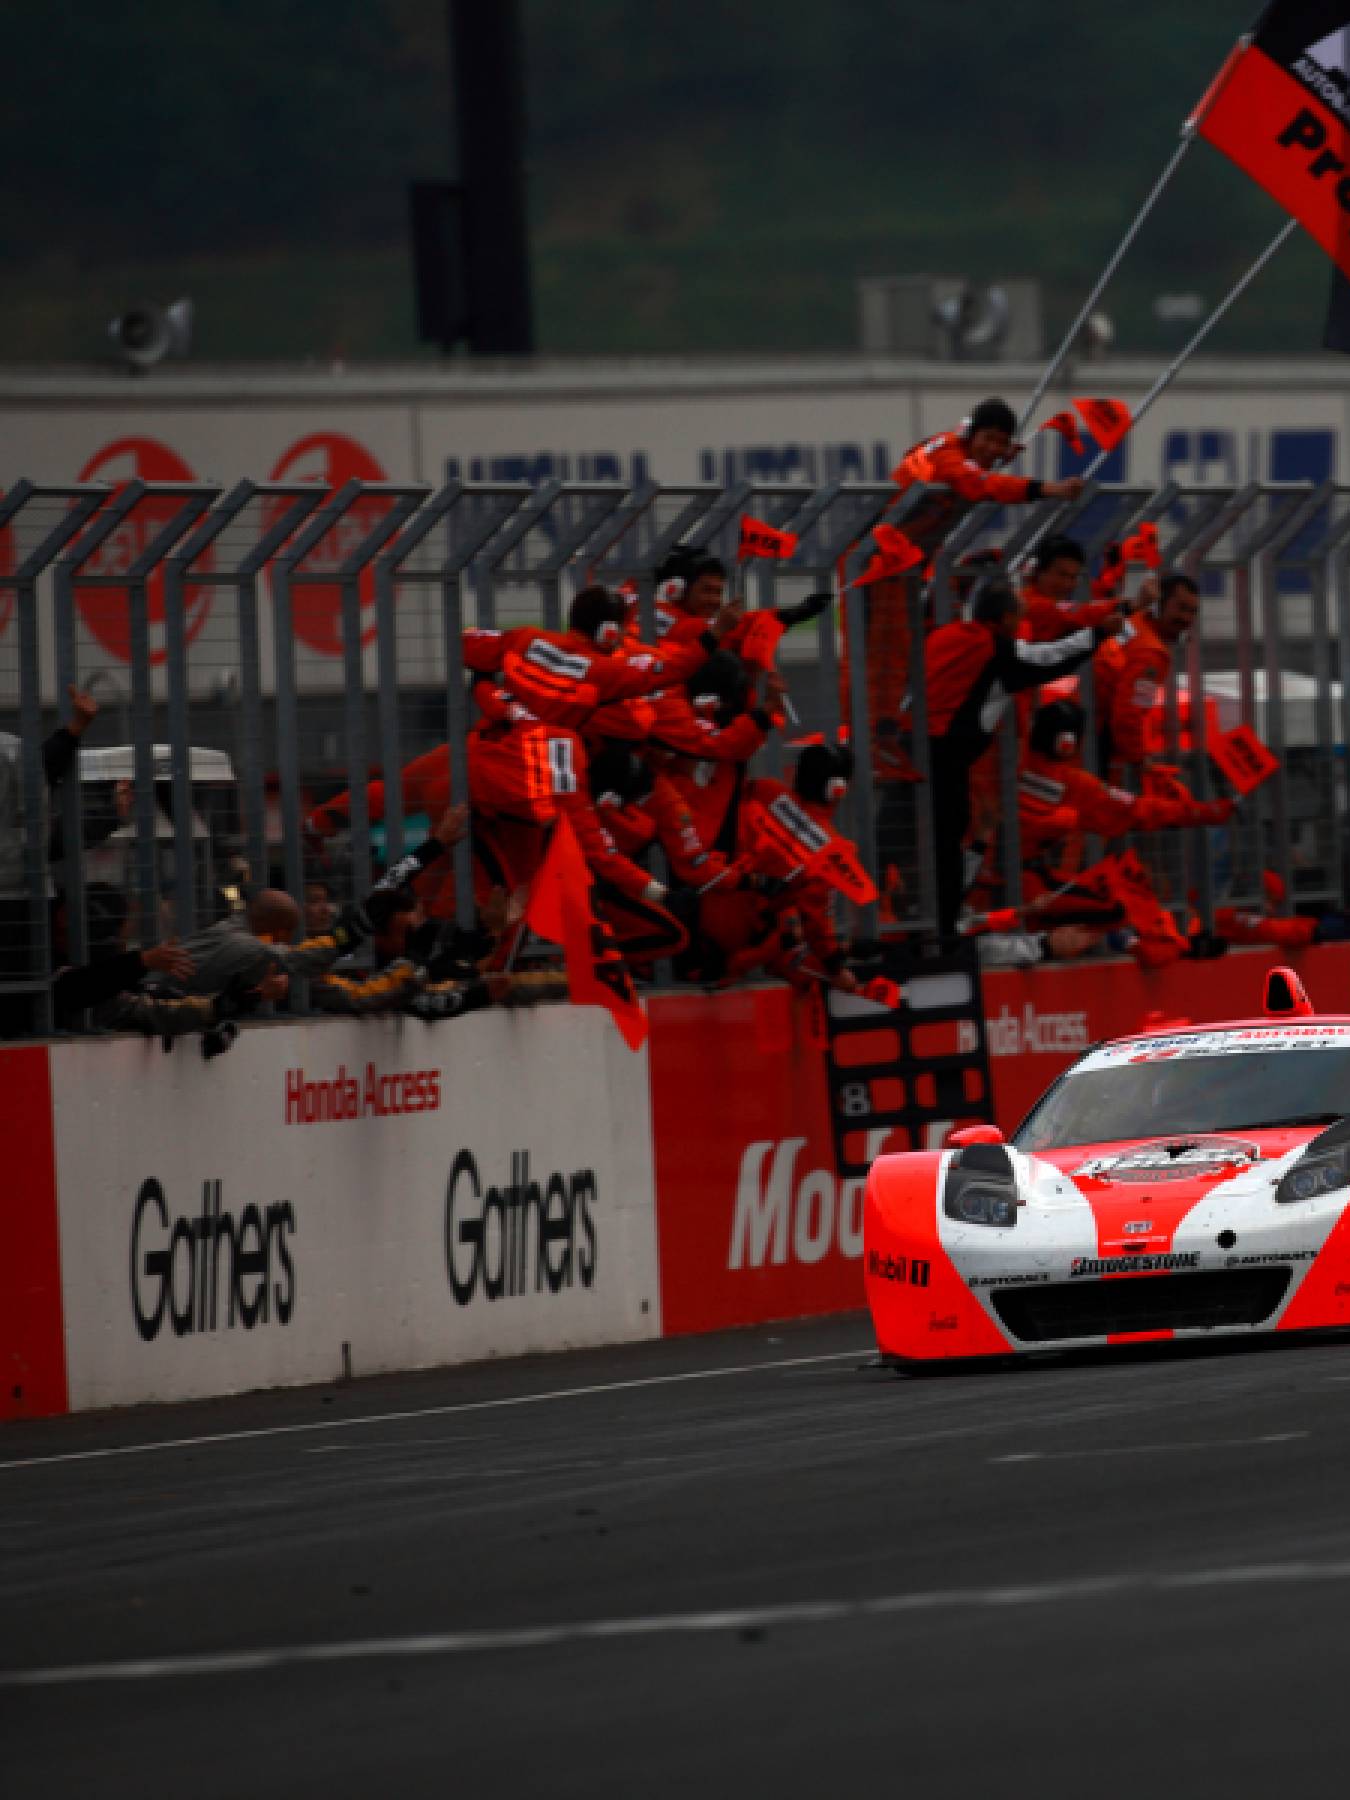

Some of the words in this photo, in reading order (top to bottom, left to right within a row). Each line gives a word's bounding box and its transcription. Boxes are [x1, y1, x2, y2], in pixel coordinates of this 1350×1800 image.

[285, 1065, 358, 1125] Honda
[363, 1062, 440, 1118] Access
[130, 1176, 295, 1342] Gathers
[444, 1148, 597, 1306] Gathers
[1070, 1251, 1200, 1277] BRIDGESTONE
